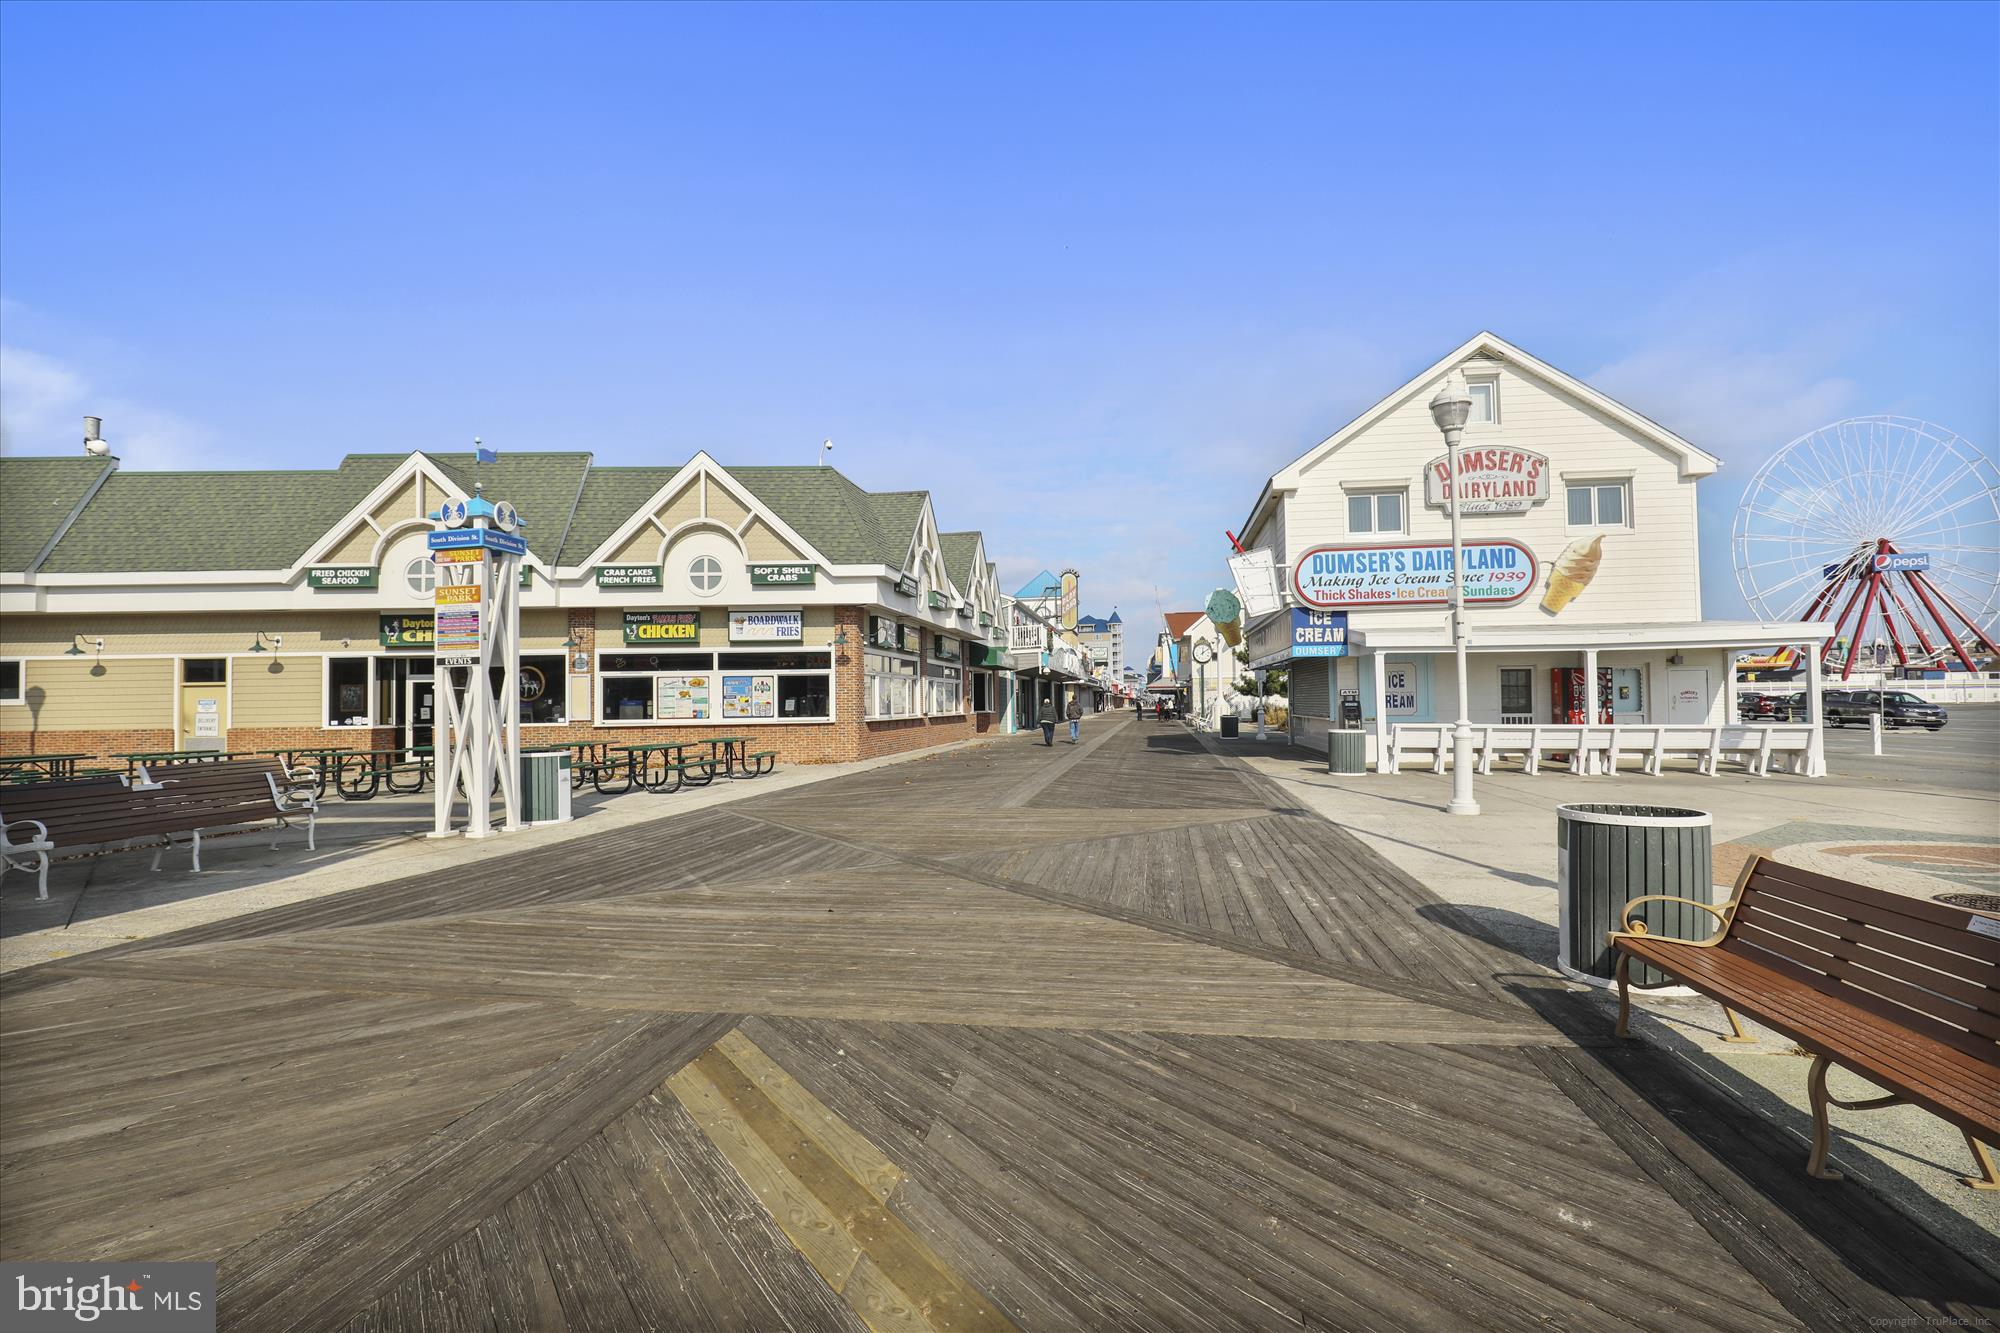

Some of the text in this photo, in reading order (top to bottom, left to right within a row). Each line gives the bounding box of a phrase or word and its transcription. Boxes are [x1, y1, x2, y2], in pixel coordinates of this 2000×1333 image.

[485, 535, 498, 544] South
[499, 538, 517, 547] Division
[1313, 551, 1406, 575] DUMSER'S
[1893, 555, 1929, 568] pepsi
[337, 569, 370, 577] CHICKEN
[628, 568, 653, 576] CAKES
[599, 576, 632, 584] FRENCH
[1302, 571, 1526, 589] Making Ice Cream Snce 1939
[439, 587, 477, 596] SUNSET
[1314, 589, 1346, 601] Thick
[1348, 588, 1391, 600] Shakes
[1397, 588, 1415, 598] Ice
[1463, 585, 1515, 597] Sundaes
[626, 614, 651, 622] Dayton's
[747, 615, 799, 625] BOARDWALK
[1309, 610, 1332, 625] ICE
[638, 624, 695, 638] CHICKEN
[776, 626, 800, 636] FRIES
[1295, 627, 1344, 643] CREAM
[1295, 645, 1345, 656] DUMSER'S
[445, 657, 472, 665] EVENTS
[1388, 673, 1405, 688] ICE
[1385, 694, 1415, 709] REAM
